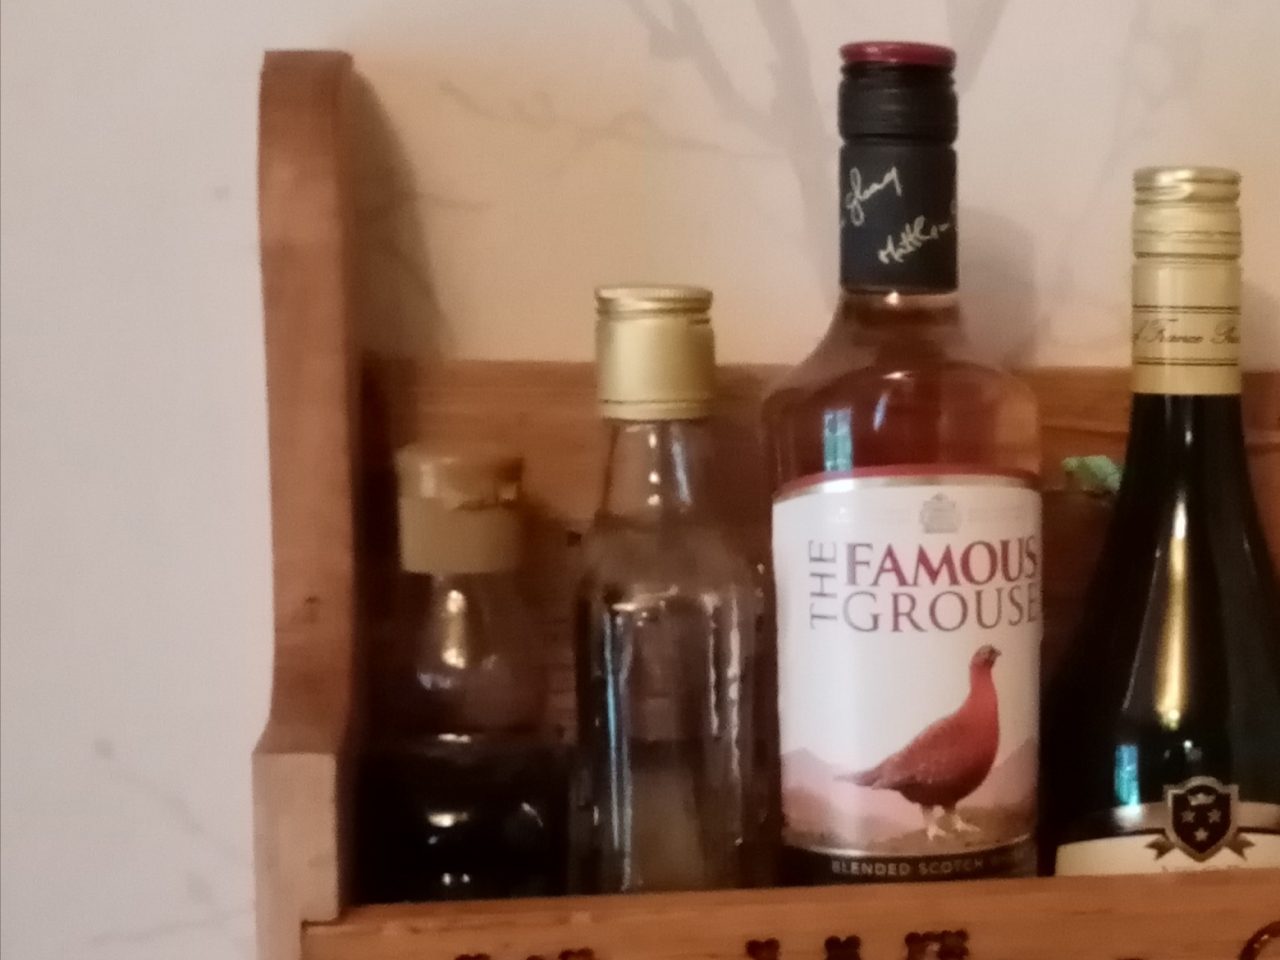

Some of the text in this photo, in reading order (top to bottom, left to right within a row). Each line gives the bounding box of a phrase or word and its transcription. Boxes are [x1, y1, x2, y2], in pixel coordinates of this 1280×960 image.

[808, 540, 838, 630] THE
[845, 535, 1038, 588] FAMOUS
[842, 583, 1040, 633] GROUSE
[831, 858, 984, 877] BLENDED SCOTCH
